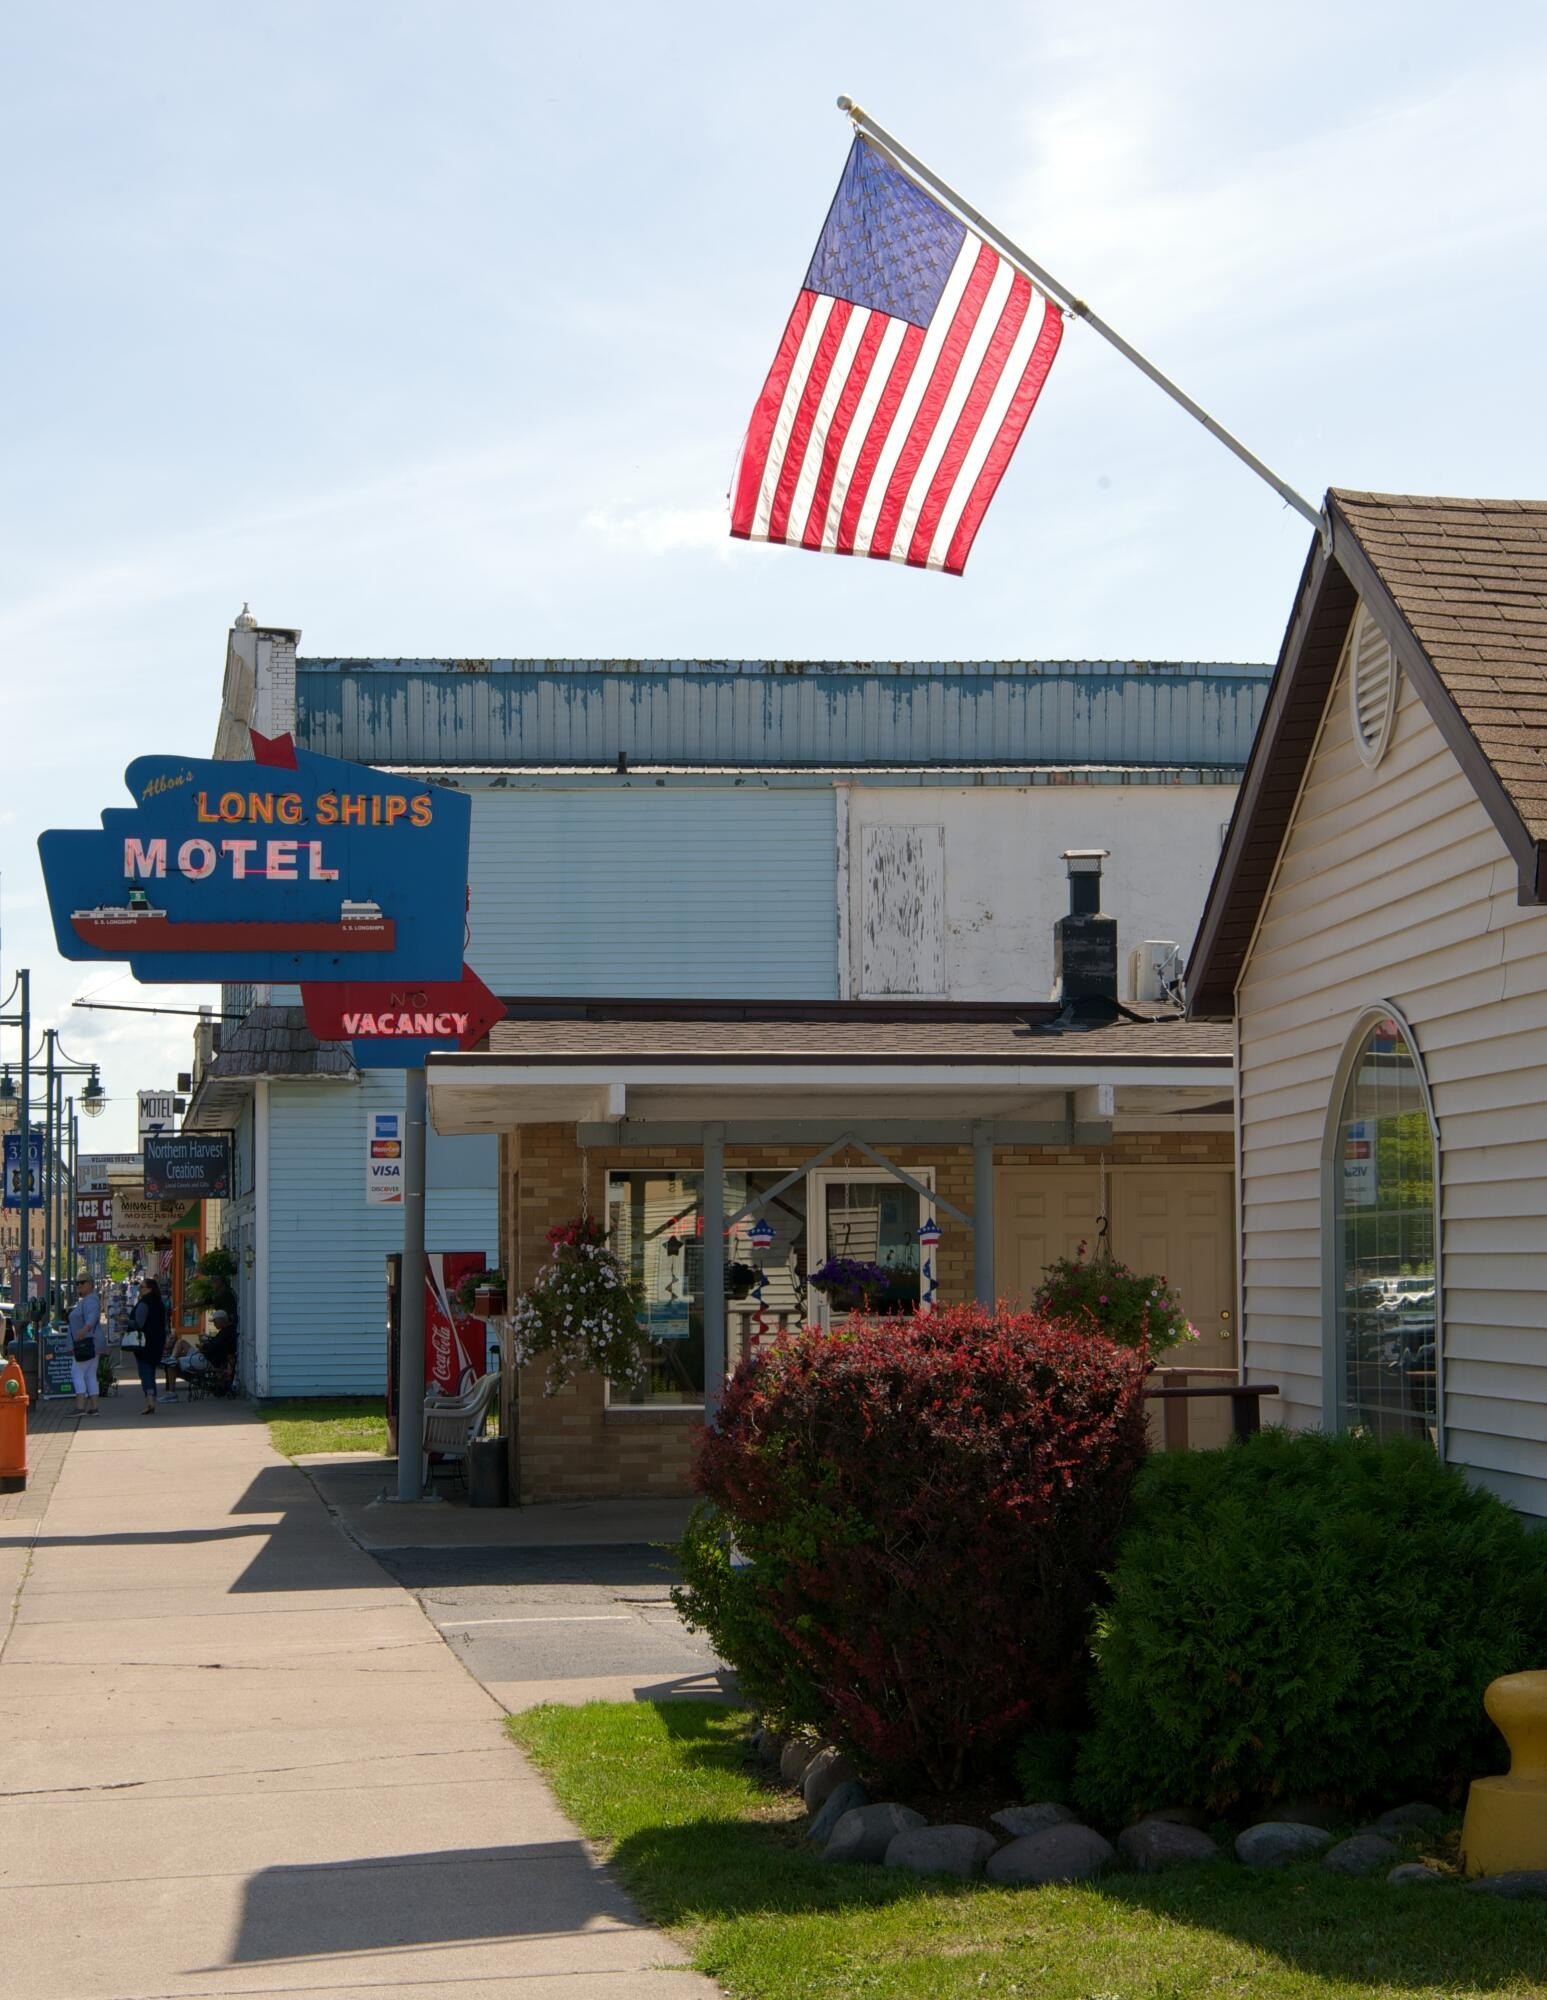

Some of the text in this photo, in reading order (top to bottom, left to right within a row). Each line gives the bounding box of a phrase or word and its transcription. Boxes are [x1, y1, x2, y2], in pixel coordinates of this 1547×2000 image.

[142, 767, 193, 800] Albon's
[198, 791, 433, 826] LONG SHIPS
[124, 838, 339, 880] MOTEL
[390, 992, 428, 1008] NO
[342, 1012, 469, 1034] VACANCY
[141, 1098, 172, 1118] MOTEL
[148, 1141, 223, 1159] Northern Harvest
[166, 1161, 204, 1180] Creations
[371, 1166, 401, 1176] VISA
[78, 1200, 98, 1217] ICE
[79, 1232, 97, 1241] TAFFY
